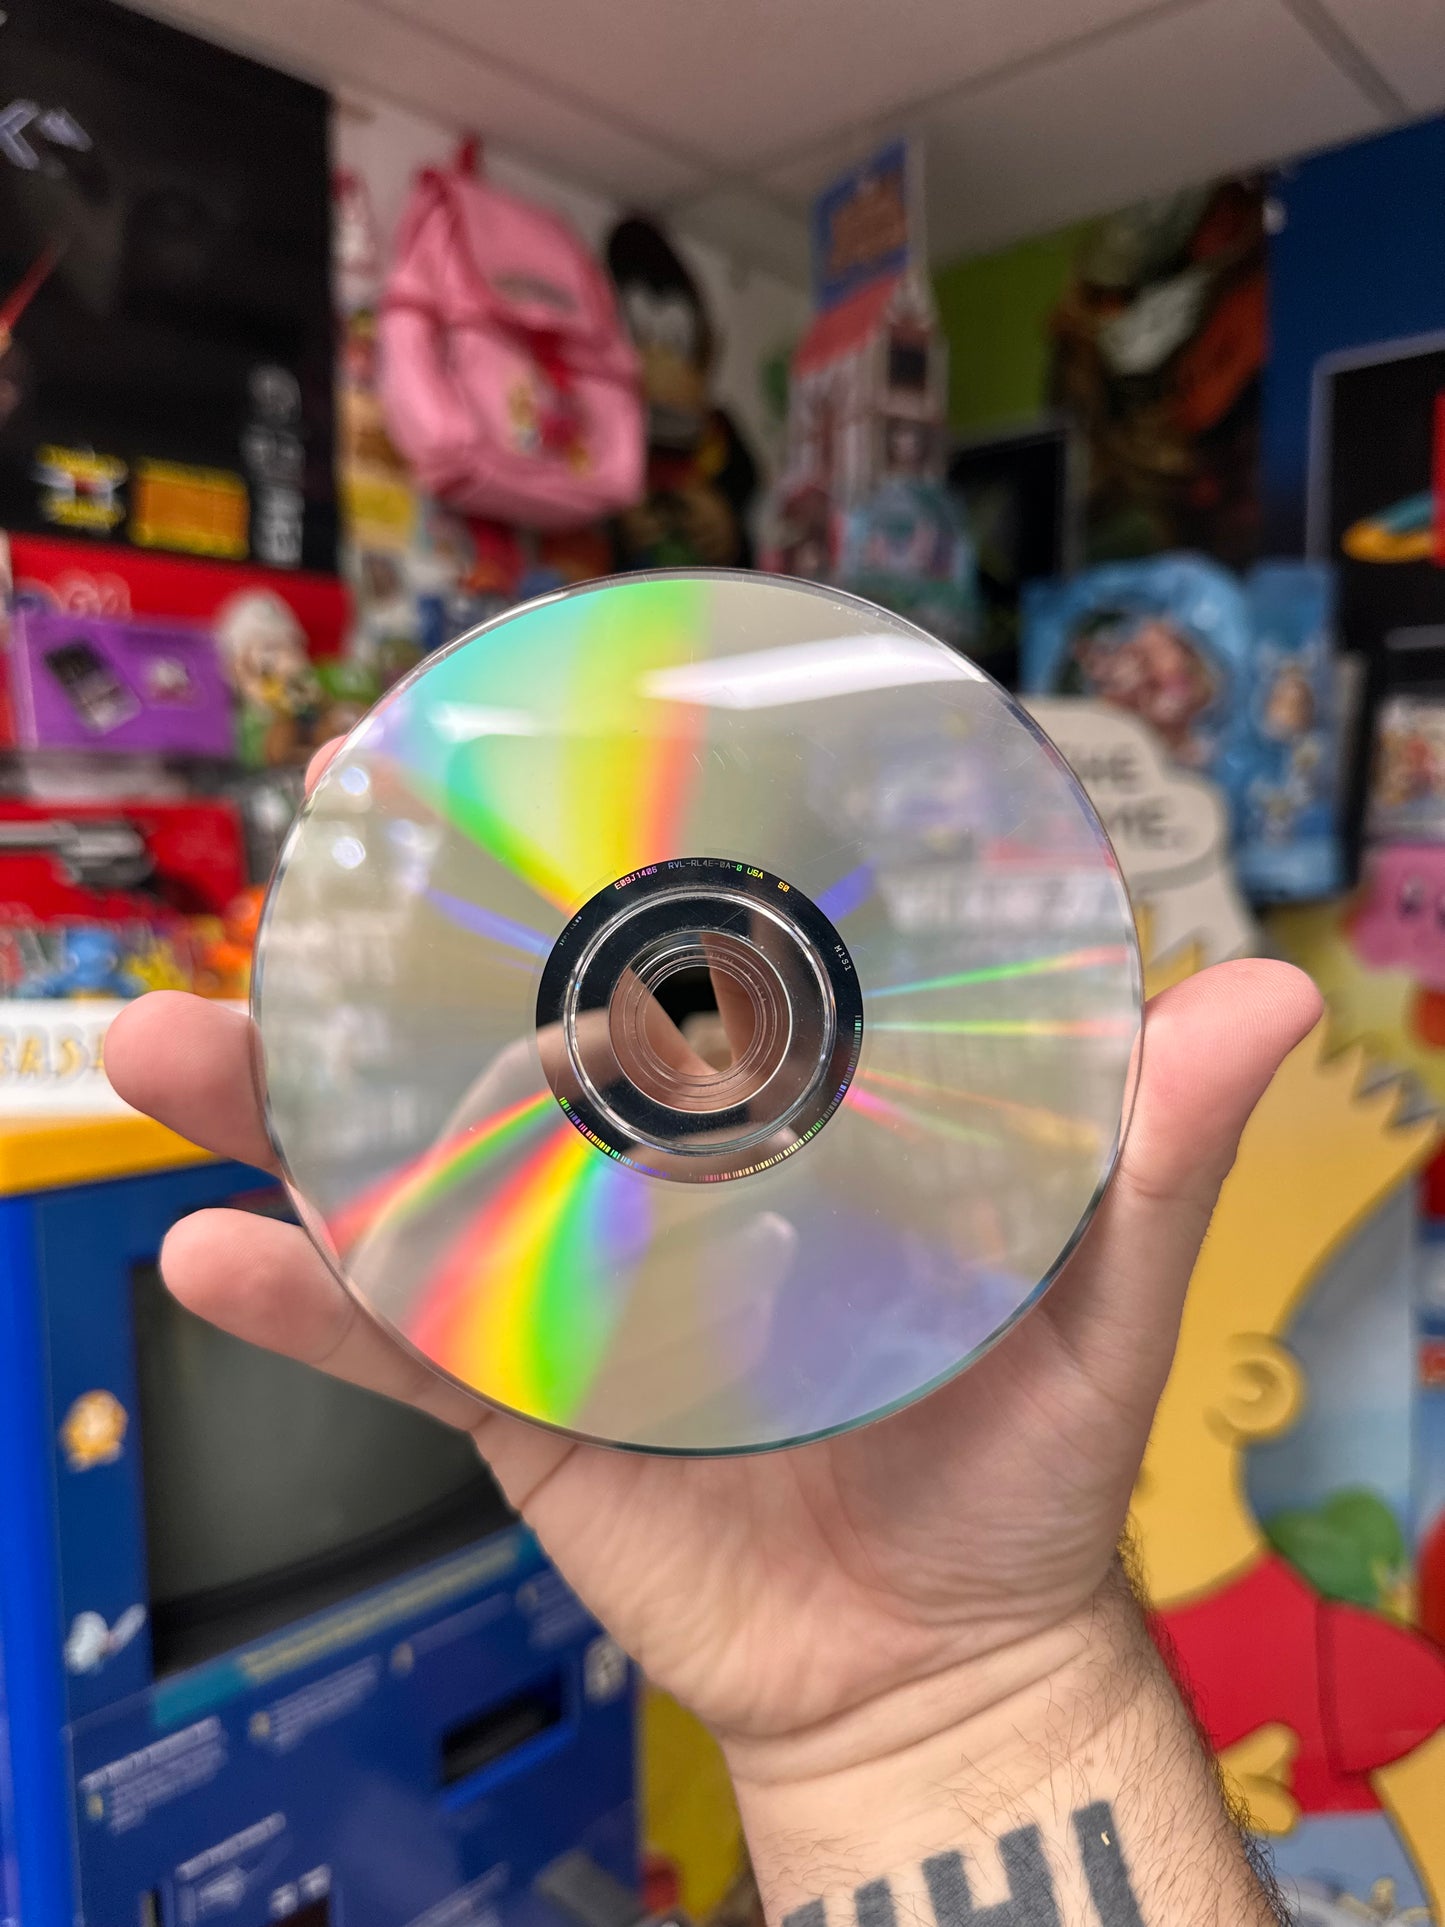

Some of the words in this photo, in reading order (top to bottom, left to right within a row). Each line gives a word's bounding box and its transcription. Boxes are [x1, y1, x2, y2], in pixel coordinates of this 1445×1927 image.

[668, 860, 742, 872] RVL-RL4E-0A-0
[746, 867, 764, 880] USA
[834, 944, 852, 971] M1S1
